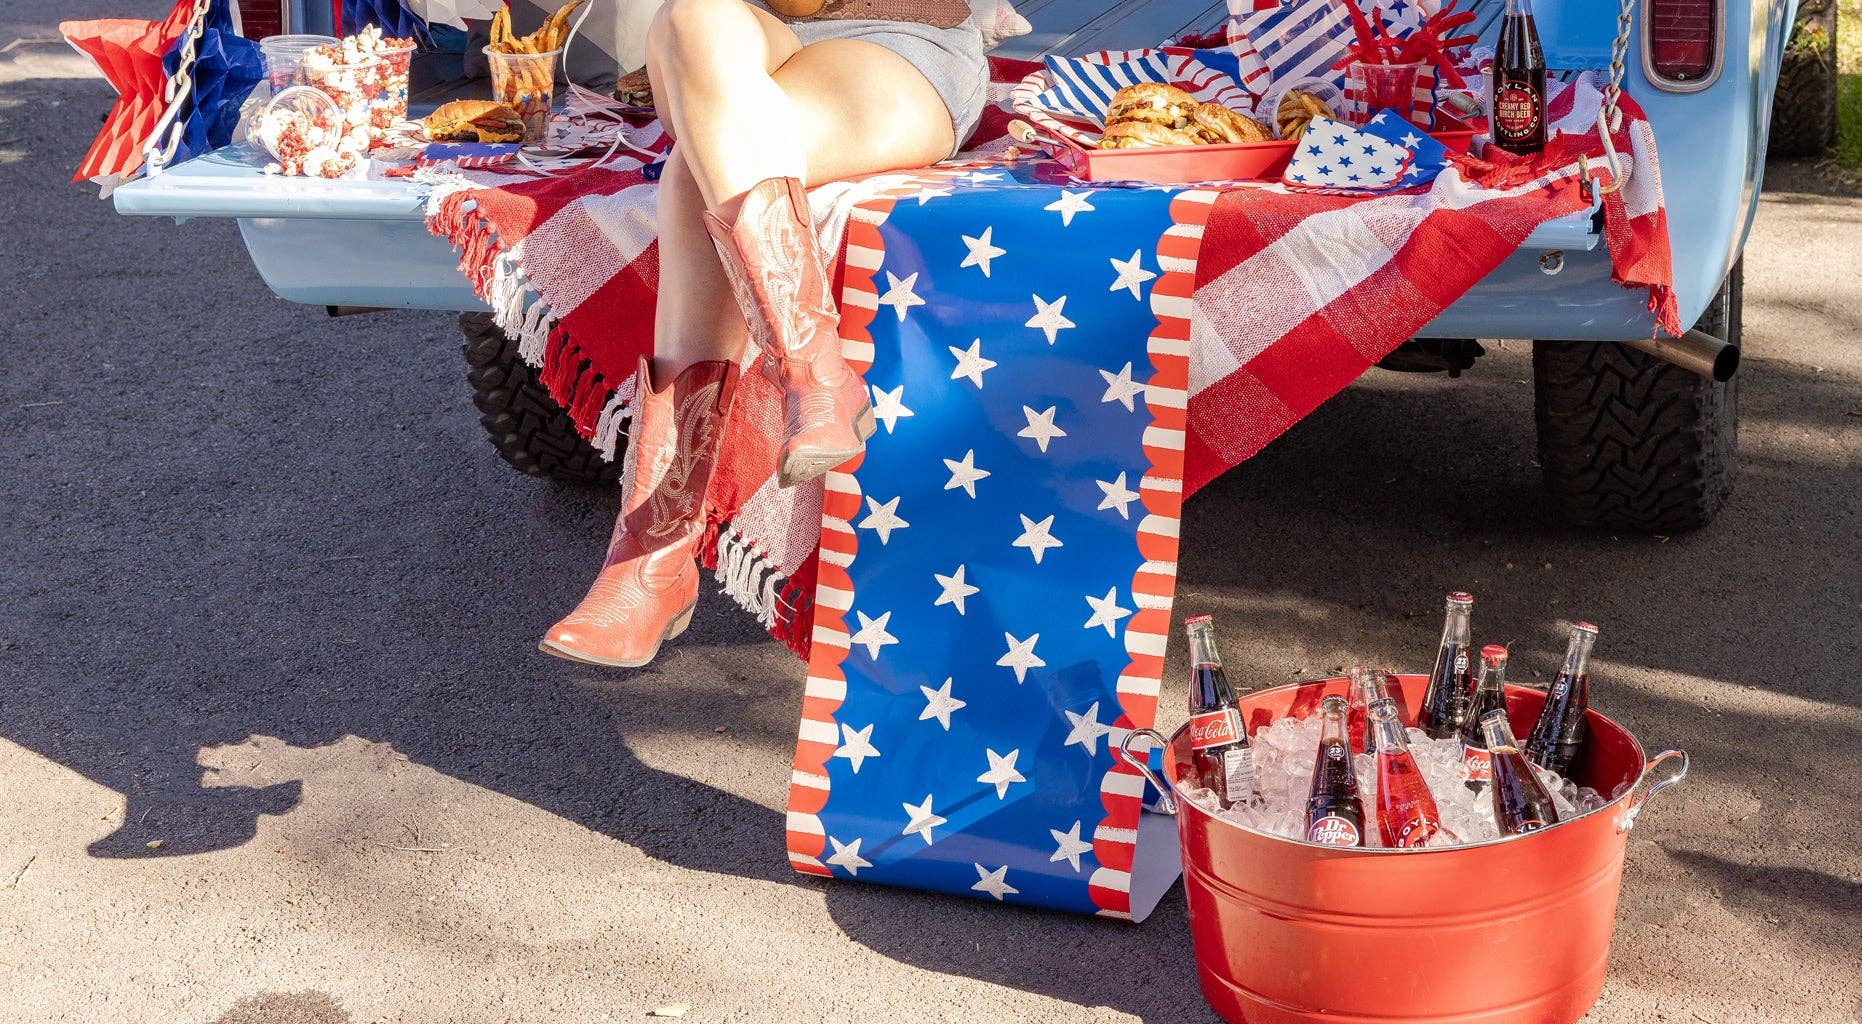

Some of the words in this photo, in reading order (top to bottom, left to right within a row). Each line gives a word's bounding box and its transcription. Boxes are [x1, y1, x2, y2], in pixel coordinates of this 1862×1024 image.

[1494, 83, 1538, 102] BOYLAN
[1499, 102, 1518, 110] CREAMY
[1519, 102, 1531, 110] RED
[1499, 109, 1515, 118] BIRCH
[1516, 110, 1531, 118] BEER
[1495, 116, 1529, 138] BOTTLING
[1324, 819, 1347, 832] Dr
[1312, 826, 1355, 844] Pepper
